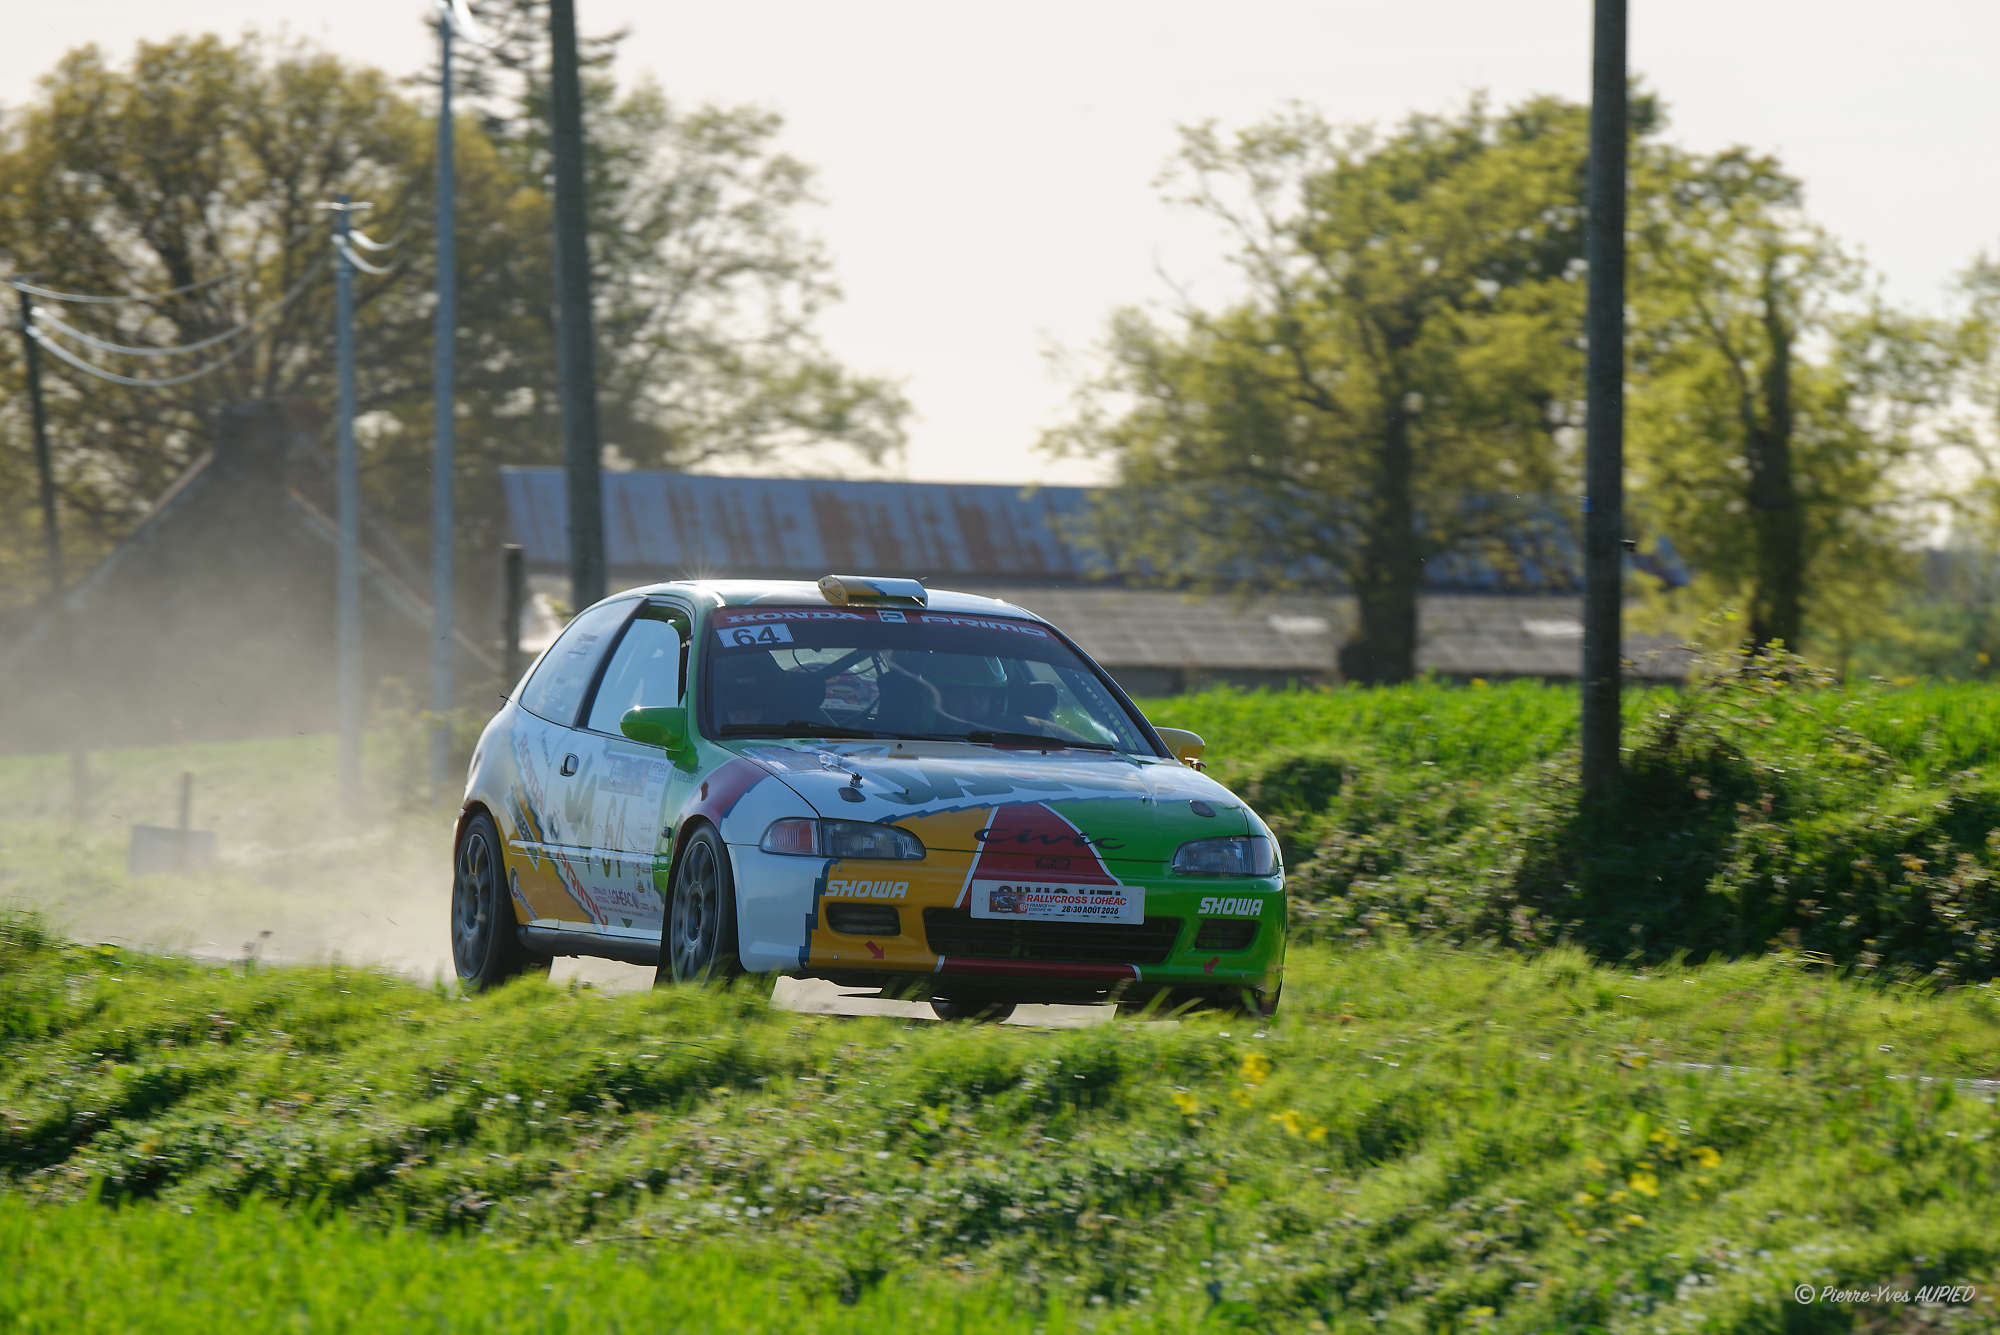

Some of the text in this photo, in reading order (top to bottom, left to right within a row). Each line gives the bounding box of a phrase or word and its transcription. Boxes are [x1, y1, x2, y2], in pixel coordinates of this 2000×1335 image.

[728, 611, 866, 623] HONDA
[732, 626, 780, 646] 64
[974, 828, 1125, 849] Civic
[825, 880, 909, 898] SHOWA
[1026, 894, 1127, 906] RALLYCROSS LOHÉAC
[1197, 897, 1263, 916] SHOWA
[1101, 906, 1119, 915] 2026
